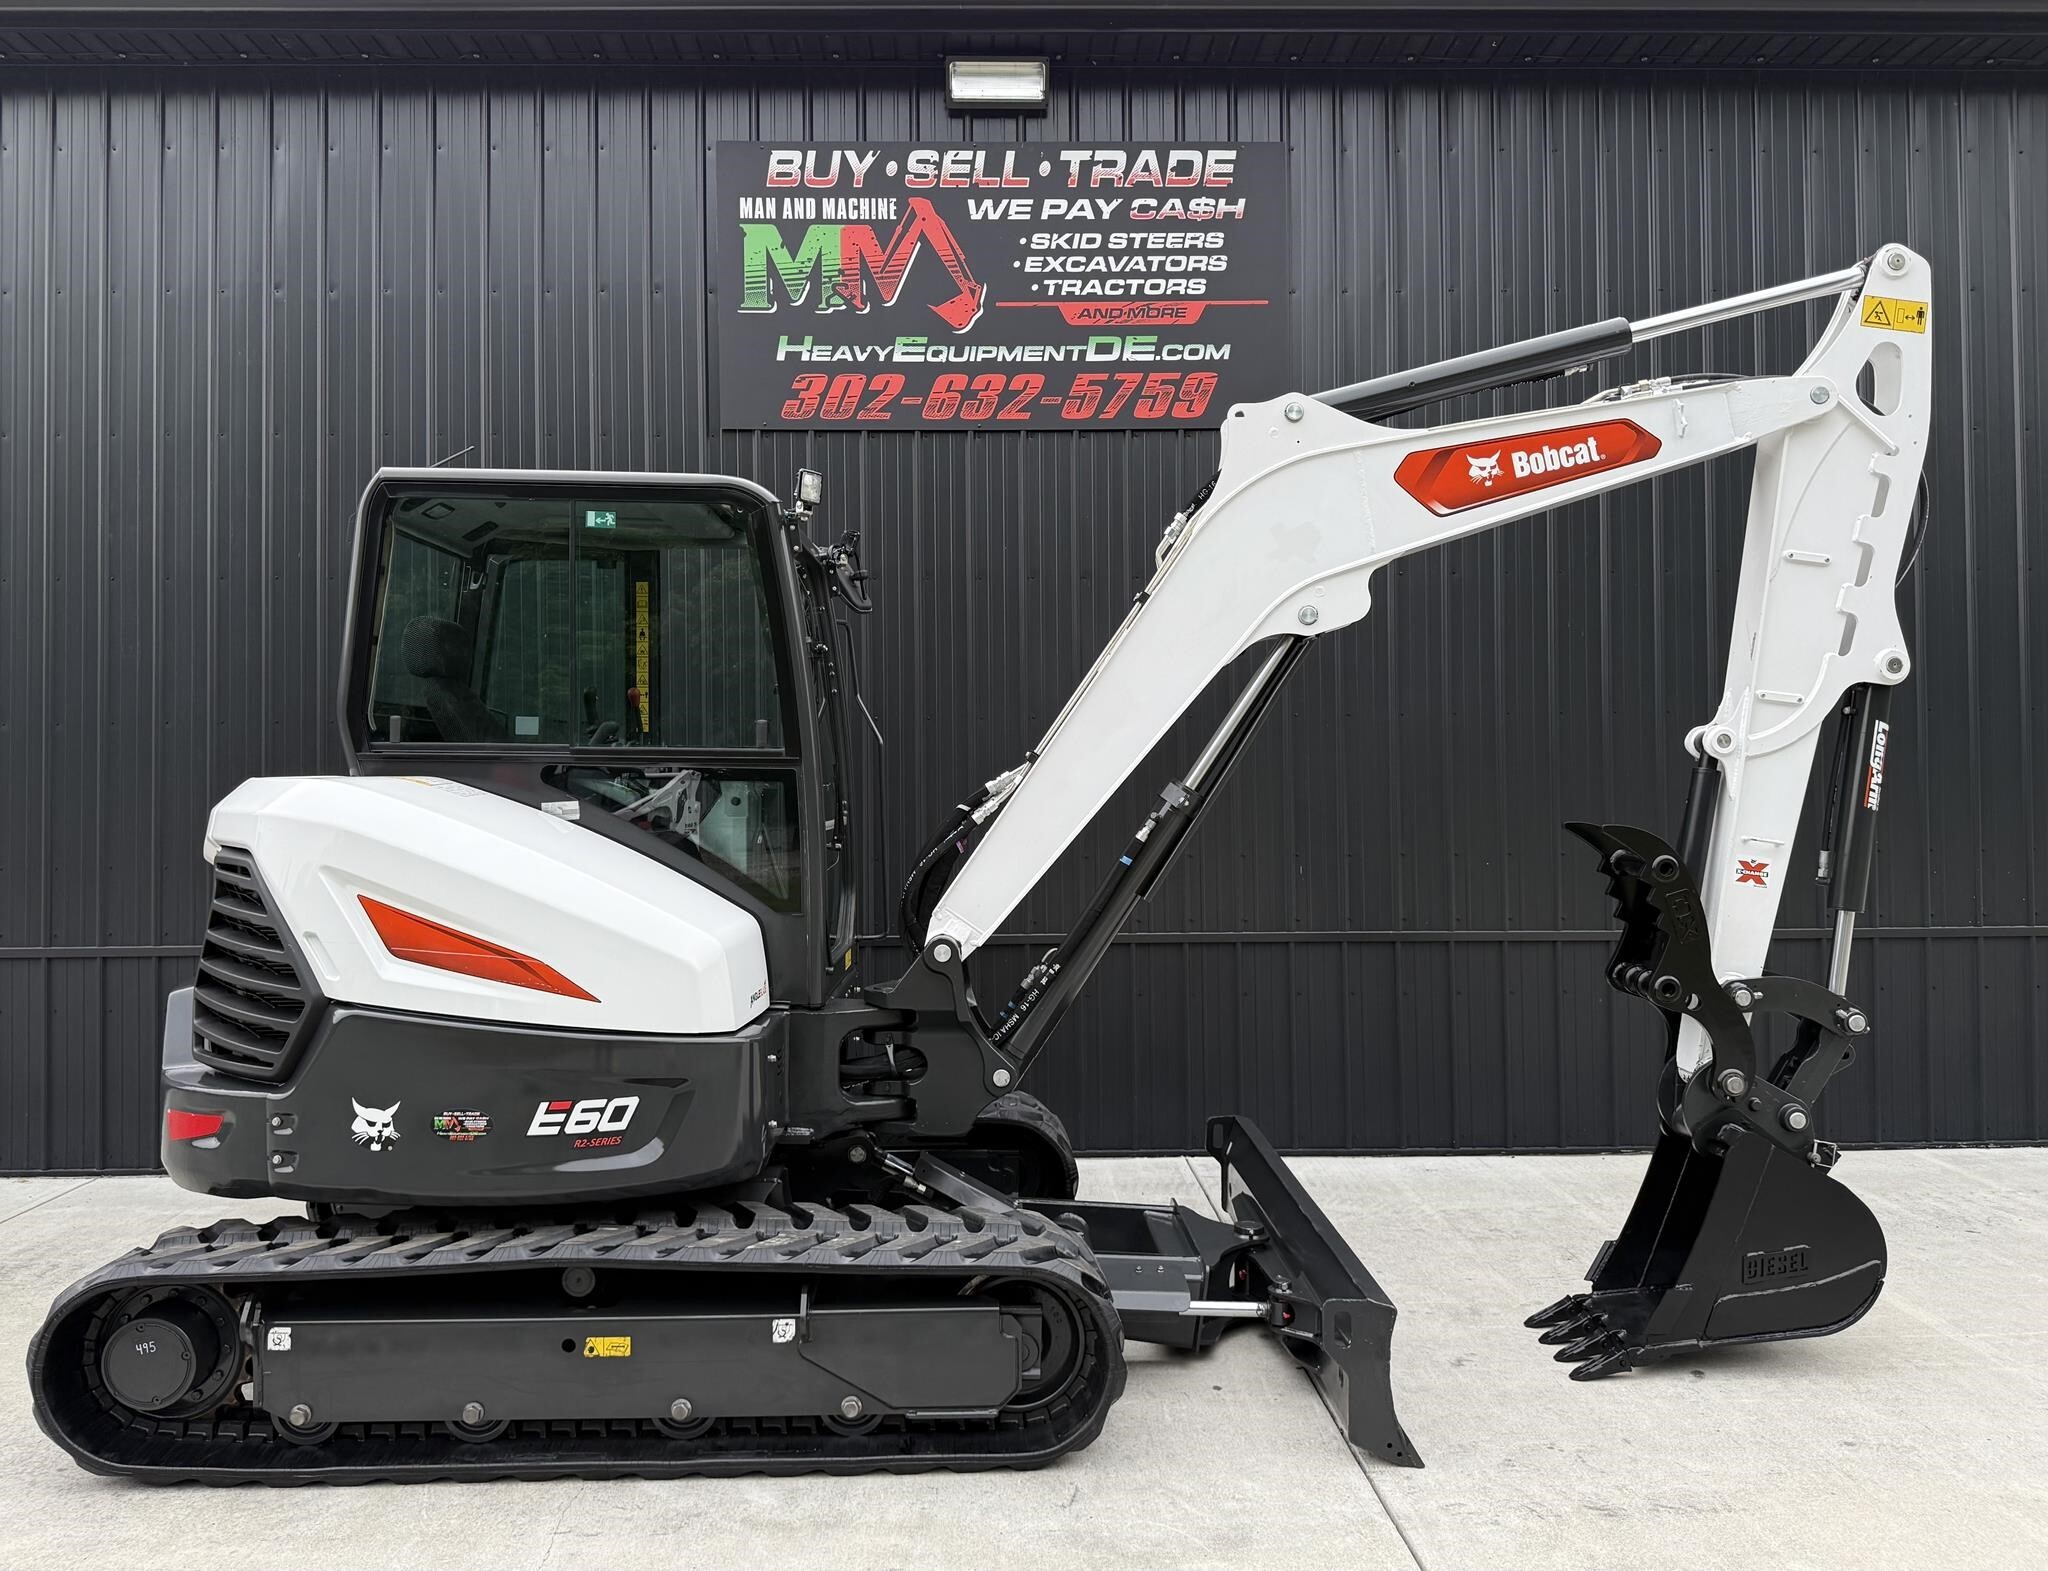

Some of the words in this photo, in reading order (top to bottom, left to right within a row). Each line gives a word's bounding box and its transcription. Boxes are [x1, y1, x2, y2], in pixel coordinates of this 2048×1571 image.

[766, 150, 881, 188] BUY
[905, 150, 1030, 188] SELL
[1060, 149, 1237, 188] TRADE
[739, 197, 776, 219] MAN
[782, 197, 816, 219] AND
[822, 197, 897, 220] MACHINE
[967, 198, 1034, 220] WE
[1040, 198, 1123, 220] PAY
[1129, 197, 1246, 221] CA$H
[1030, 232, 1101, 249] SKID
[1108, 231, 1225, 249] STEERS
[1024, 255, 1228, 272] EXCAVATORS
[1043, 279, 1207, 296] TRACTORS
[1077, 307, 1124, 320] AND
[1130, 307, 1188, 320] MORE
[780, 372, 1219, 421] 302-632-5759
[1511, 436, 1601, 478] Bobcat
[526, 1096, 640, 1136] E60
[573, 1136, 622, 1148] R2-SERIES
[1746, 1252, 1809, 1279] DIESEL
[135, 1341, 156, 1355] 495
